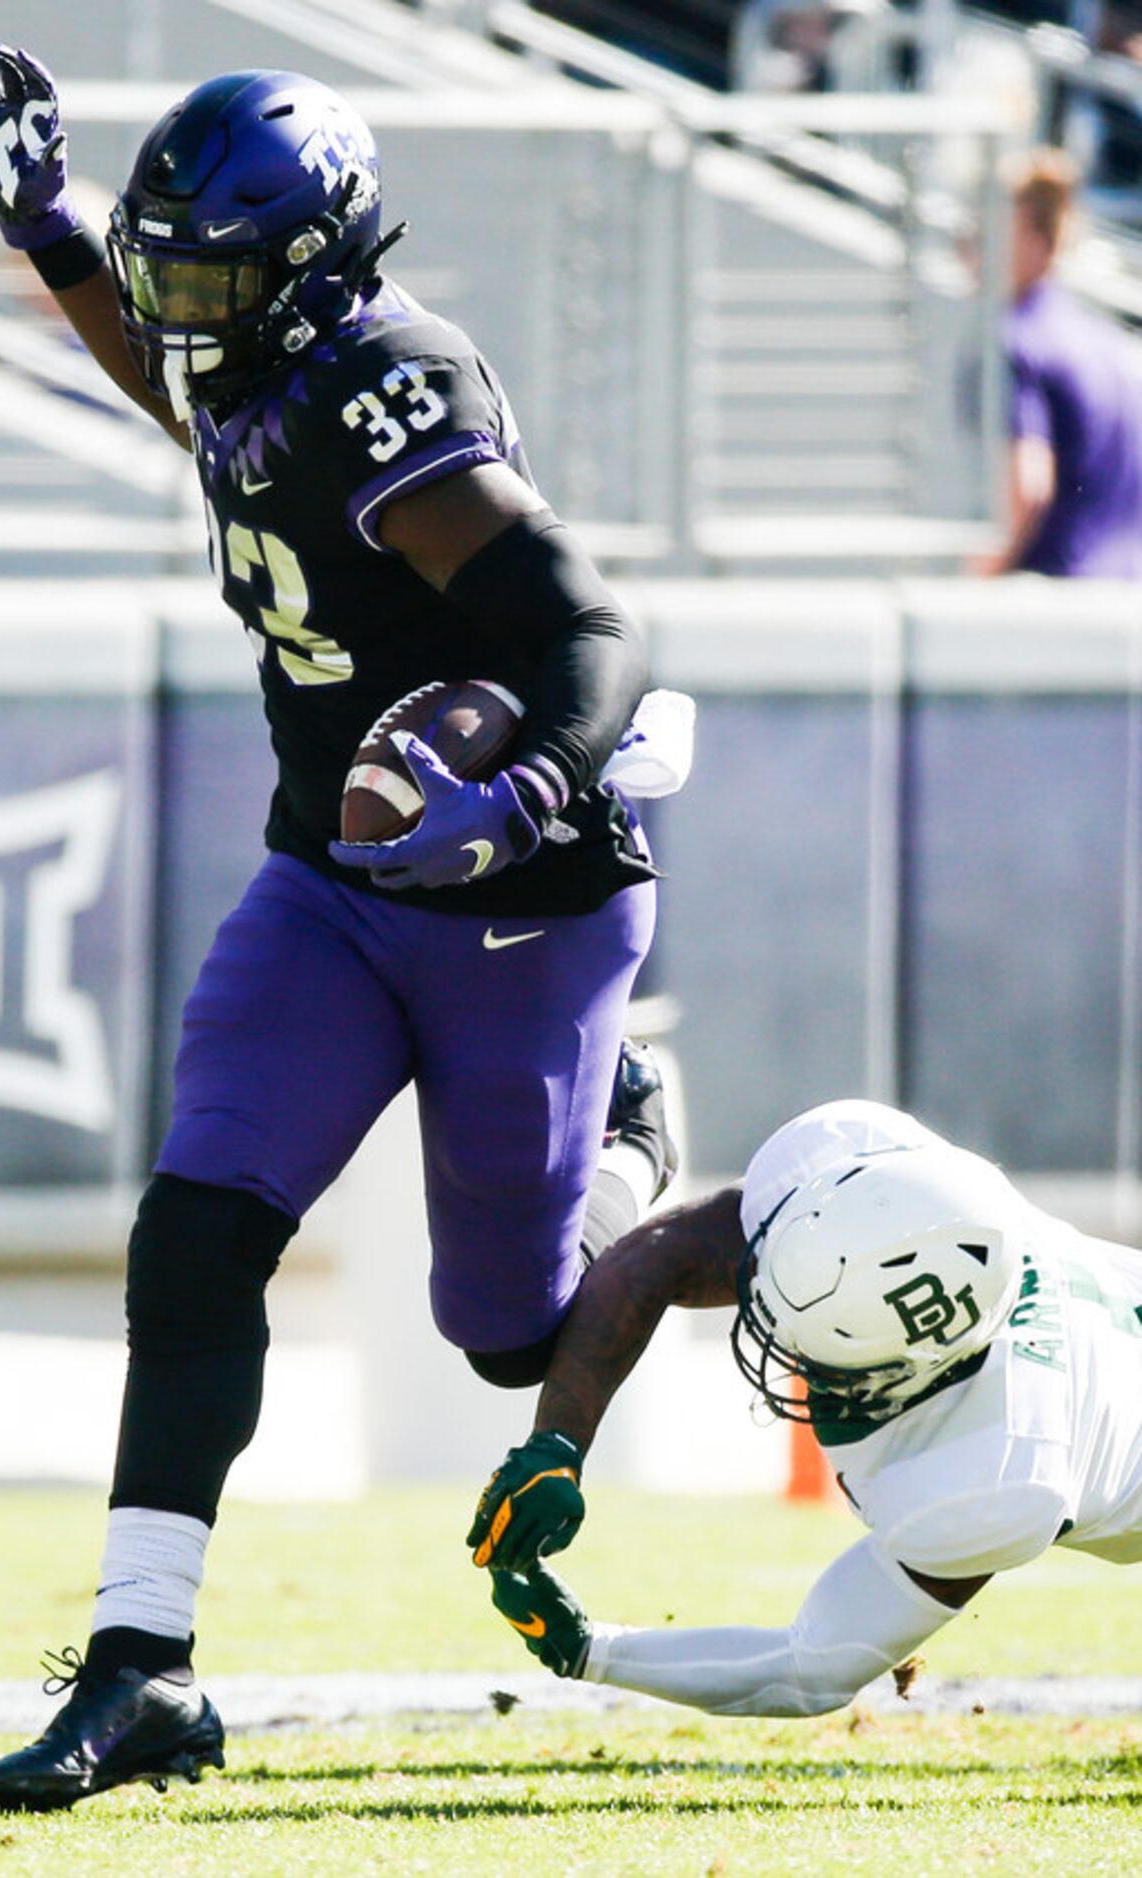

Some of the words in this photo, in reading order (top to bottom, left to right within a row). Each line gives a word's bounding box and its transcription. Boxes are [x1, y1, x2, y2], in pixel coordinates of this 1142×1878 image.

[342, 360, 446, 462] 33
[205, 496, 355, 686] 3
[883, 1272, 981, 1346] BU
